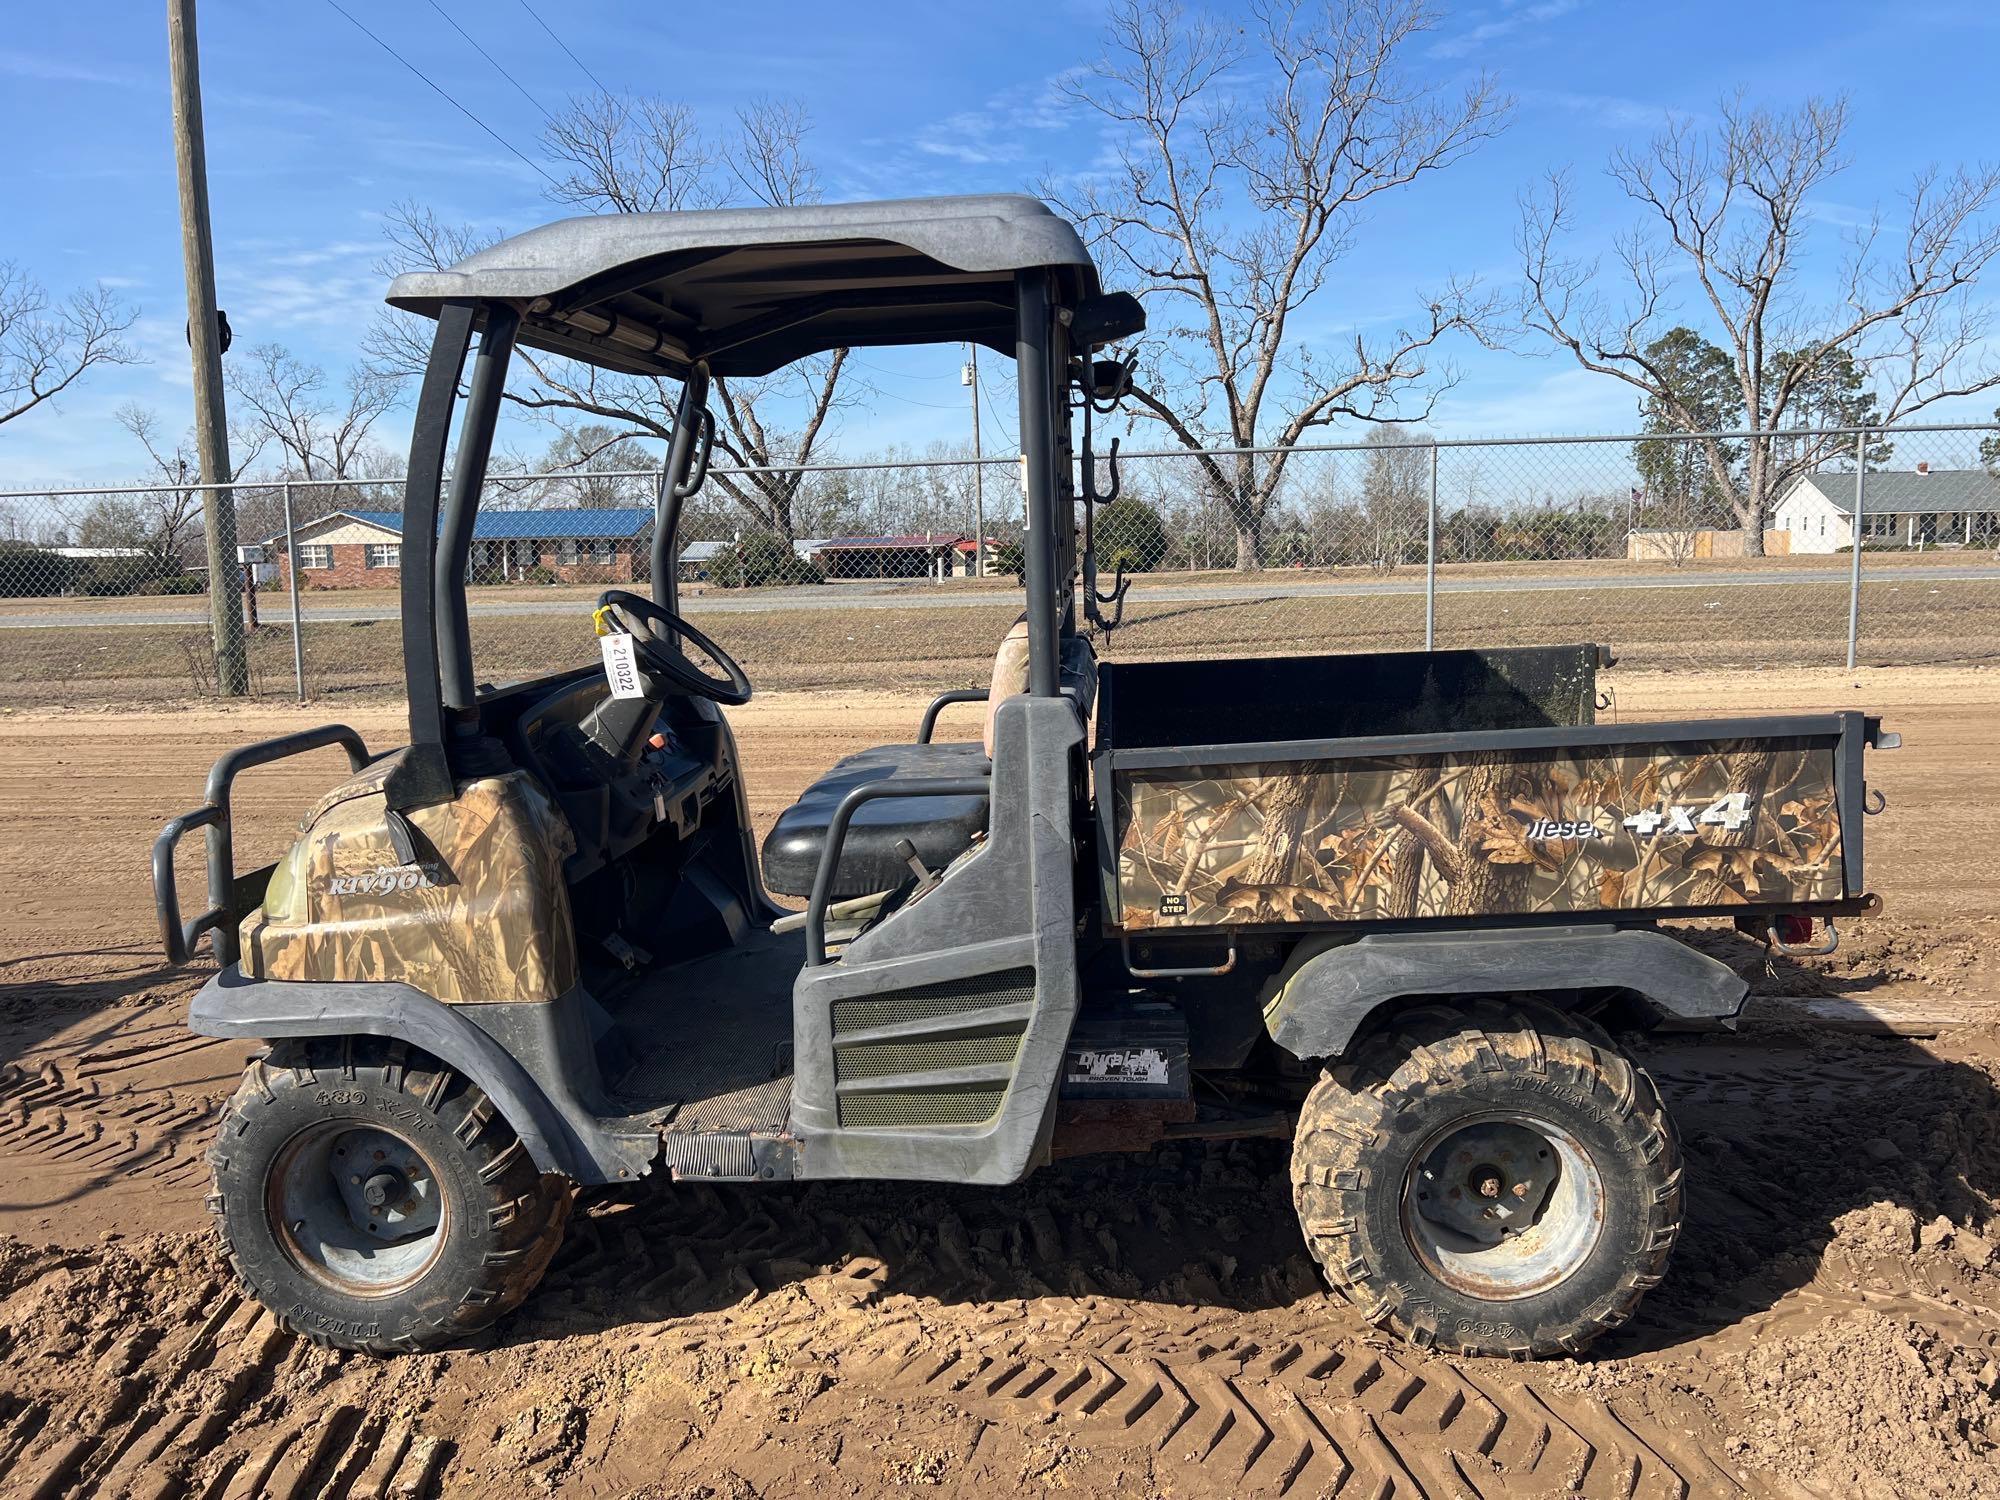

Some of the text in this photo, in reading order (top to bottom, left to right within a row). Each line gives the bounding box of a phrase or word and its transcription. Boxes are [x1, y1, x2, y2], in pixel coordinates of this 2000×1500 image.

[613, 648, 635, 691] 210322
[329, 871, 442, 897] RTV900
[315, 1089, 368, 1106] 489
[1511, 1074, 1610, 1123] TITAN
[289, 1303, 383, 1339] TITAN
